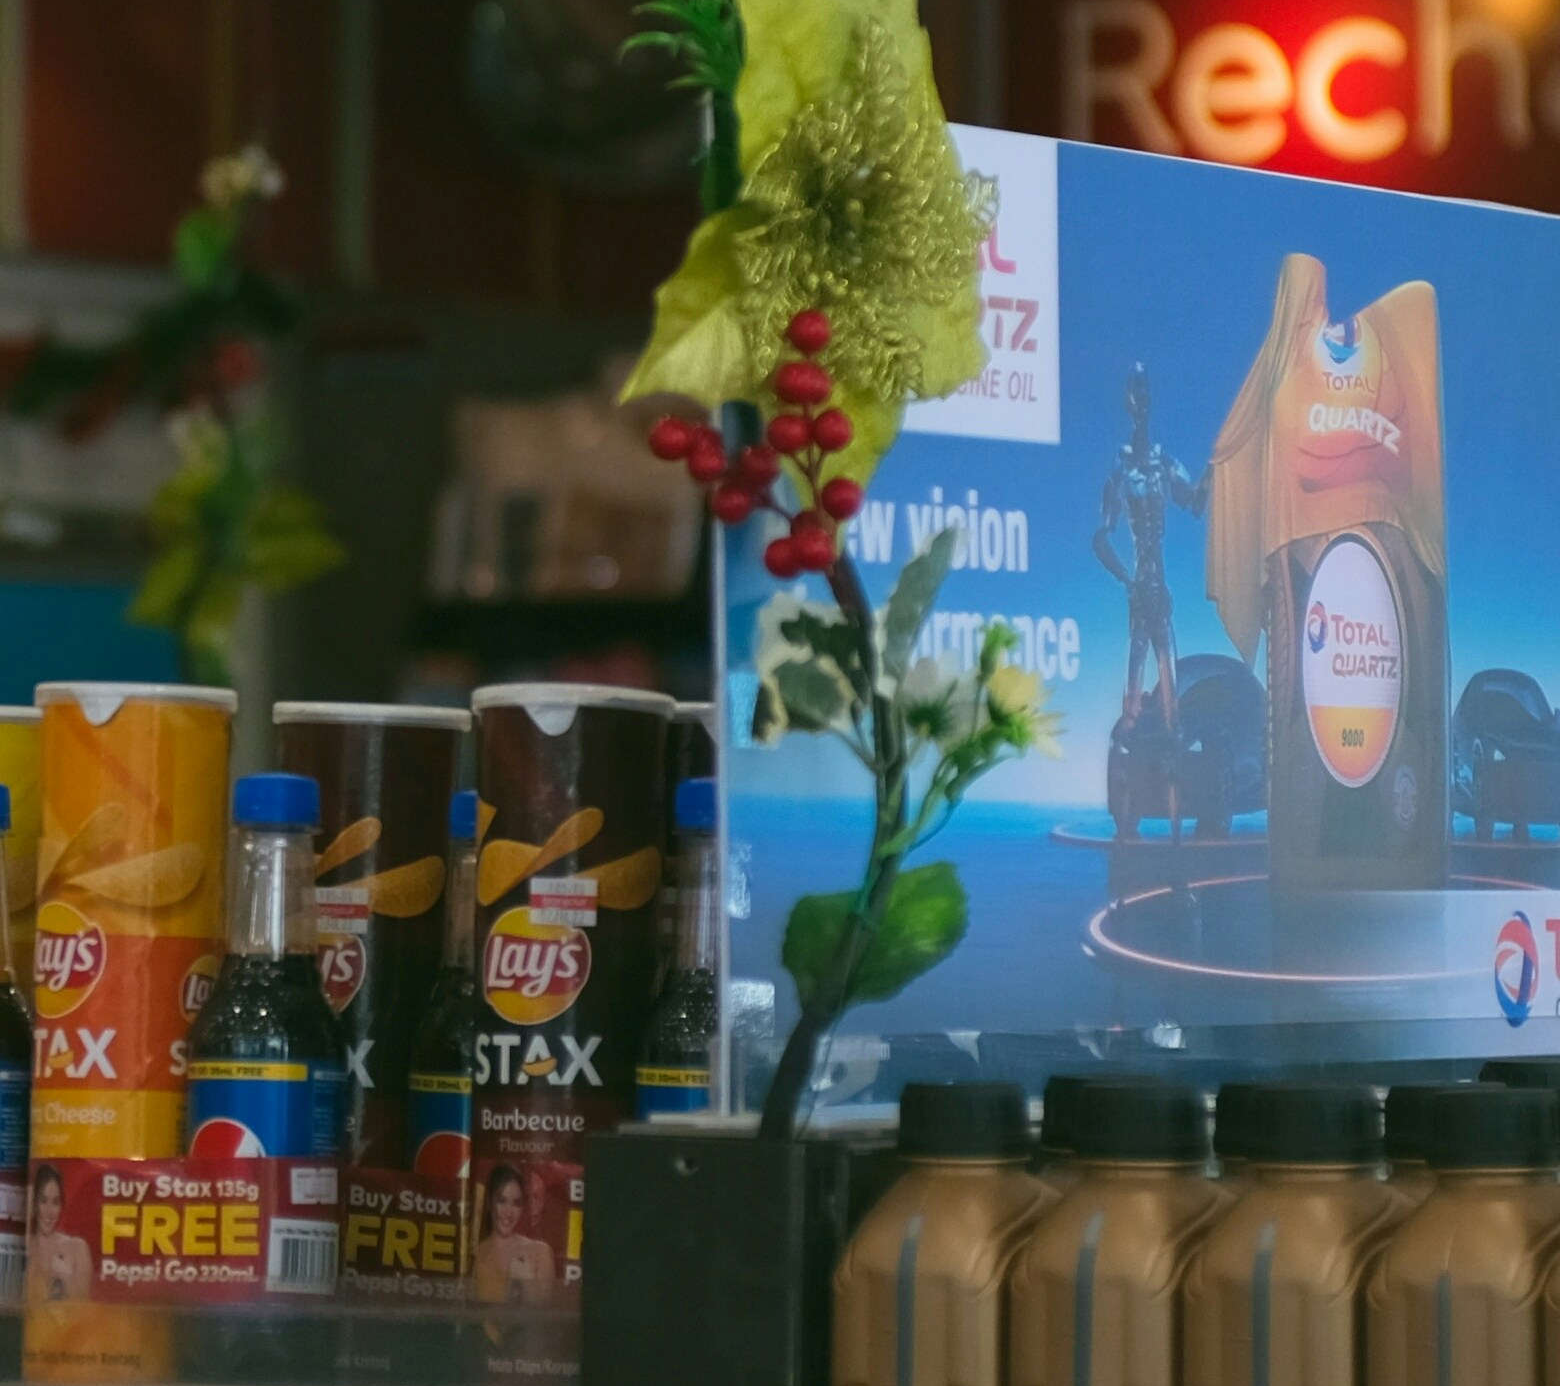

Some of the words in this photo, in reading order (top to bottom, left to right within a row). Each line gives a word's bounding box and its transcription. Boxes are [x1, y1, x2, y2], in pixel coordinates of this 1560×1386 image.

[1007, 370, 1038, 403] OIL
[1322, 371, 1376, 394] TOTAL
[1308, 403, 1402, 454] QUARTZ
[1331, 614, 1389, 647] TOTAL
[1332, 653, 1398, 679] QUARTZ
[1341, 727, 1365, 748] 9000
[487, 936, 582, 997] Lay's
[476, 1034, 603, 1086] STAX
[482, 1109, 584, 1132] Barbecue
[102, 1174, 149, 1200] Buy
[155, 1175, 212, 1199] Stax
[217, 1180, 260, 1203] 135g
[350, 1185, 393, 1212] Buy
[398, 1190, 452, 1216] Stax
[101, 1204, 260, 1256] FREE
[344, 1214, 456, 1274] FRE
[101, 1259, 161, 1286] Pepsi
[164, 1260, 197, 1283] Go
[199, 1263, 260, 1284] 330mL
[342, 1266, 399, 1296] Pepsi
[403, 1273, 432, 1298] Go
